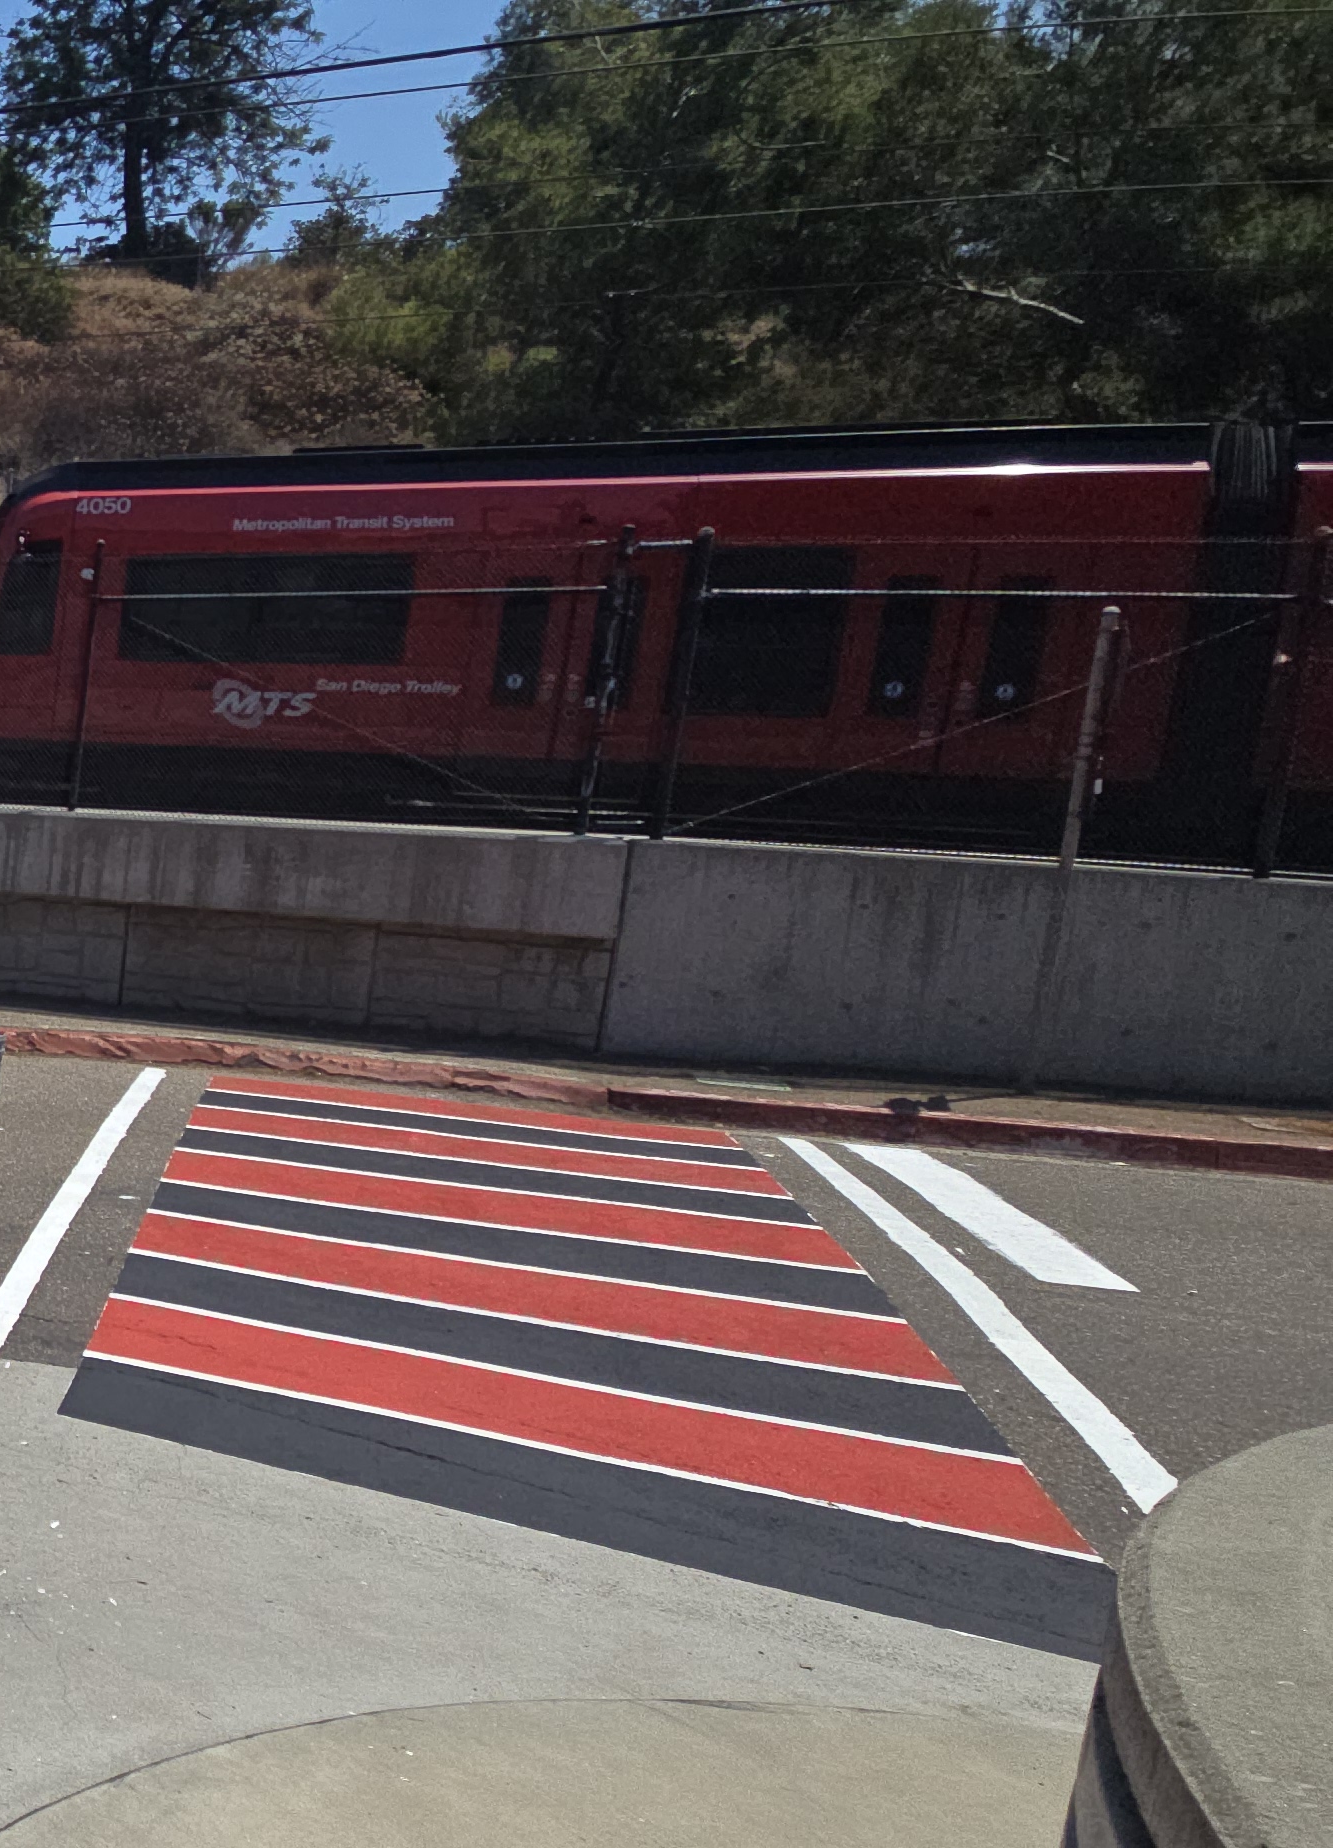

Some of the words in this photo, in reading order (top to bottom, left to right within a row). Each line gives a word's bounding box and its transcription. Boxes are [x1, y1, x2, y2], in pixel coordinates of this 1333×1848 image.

[76, 497, 132, 515] 4050
[233, 518, 331, 532] Metropolitan
[335, 515, 388, 529] Transit
[392, 515, 454, 531] System
[316, 678, 347, 691] San
[352, 680, 401, 695] Diego
[405, 680, 462, 697] Trolley
[213, 690, 318, 718] MTS
